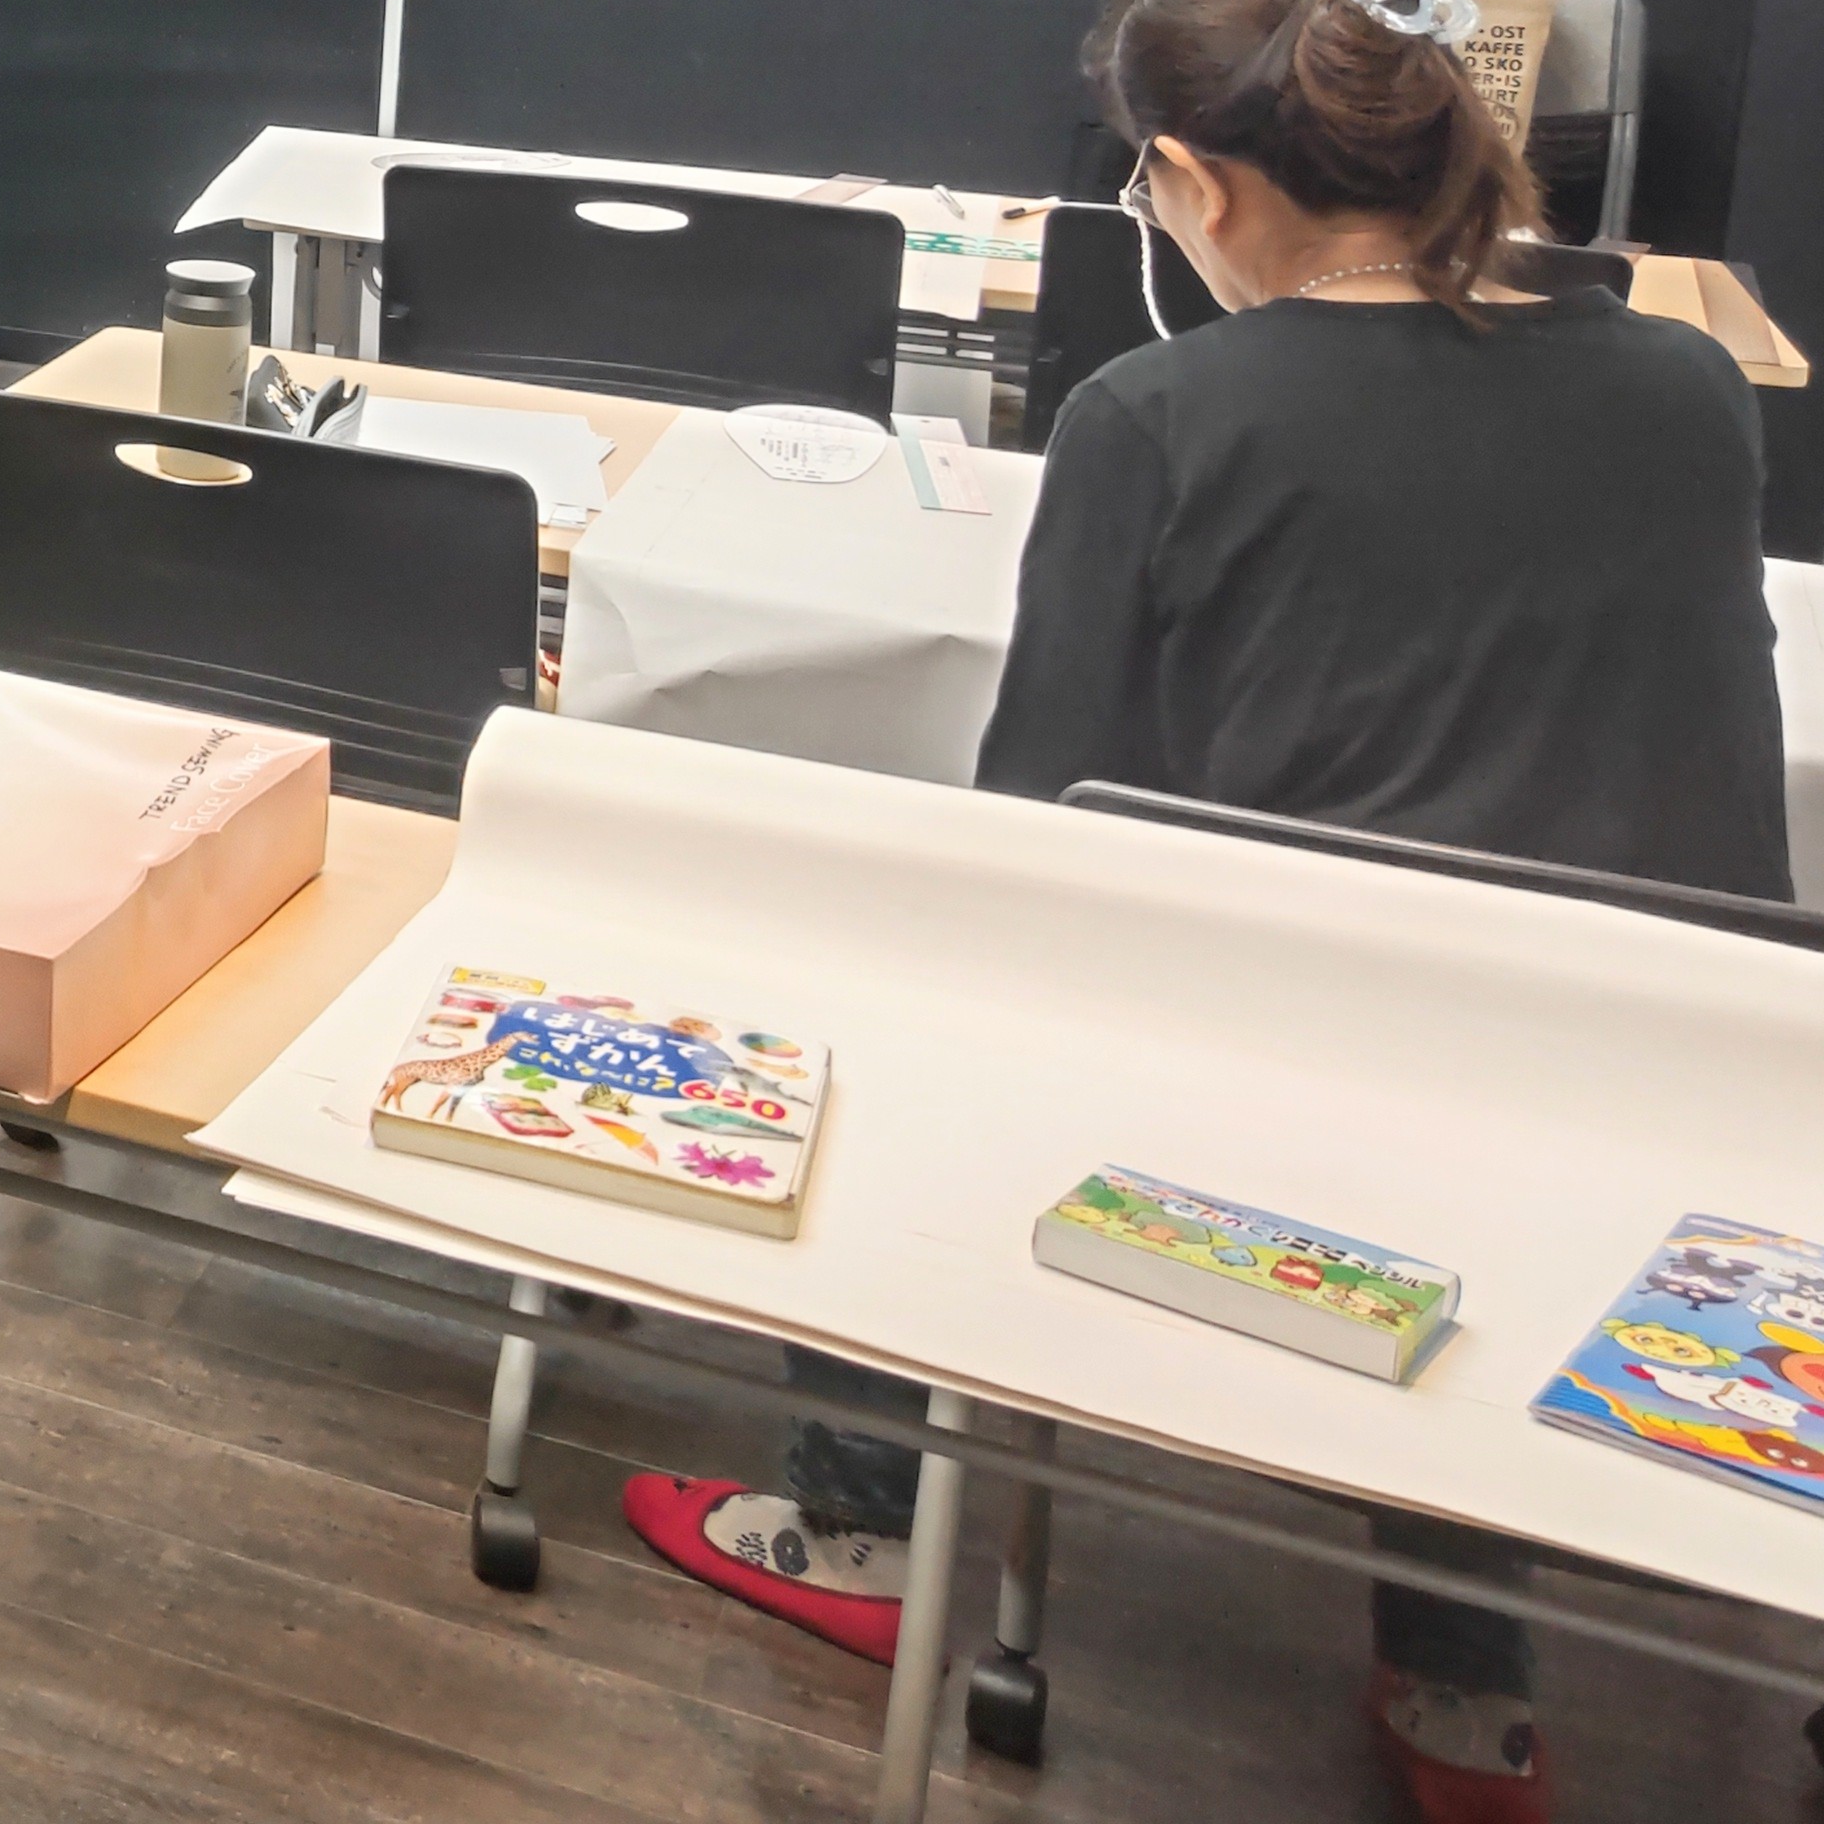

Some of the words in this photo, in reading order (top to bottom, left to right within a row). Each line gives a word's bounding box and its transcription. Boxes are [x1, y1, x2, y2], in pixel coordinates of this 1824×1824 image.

[1464, 40, 1525, 56] KAFFE
[1490, 25, 1526, 39] OST
[1484, 57, 1523, 72] SKO
[138, 773, 192, 821] TREND
[180, 727, 242, 776] SEWING
[169, 795, 231, 833] Face
[208, 740, 275, 794] Cover
[521, 1006, 708, 1059] はじめて
[547, 1031, 678, 1078] ずかん
[680, 1081, 787, 1122] 650
